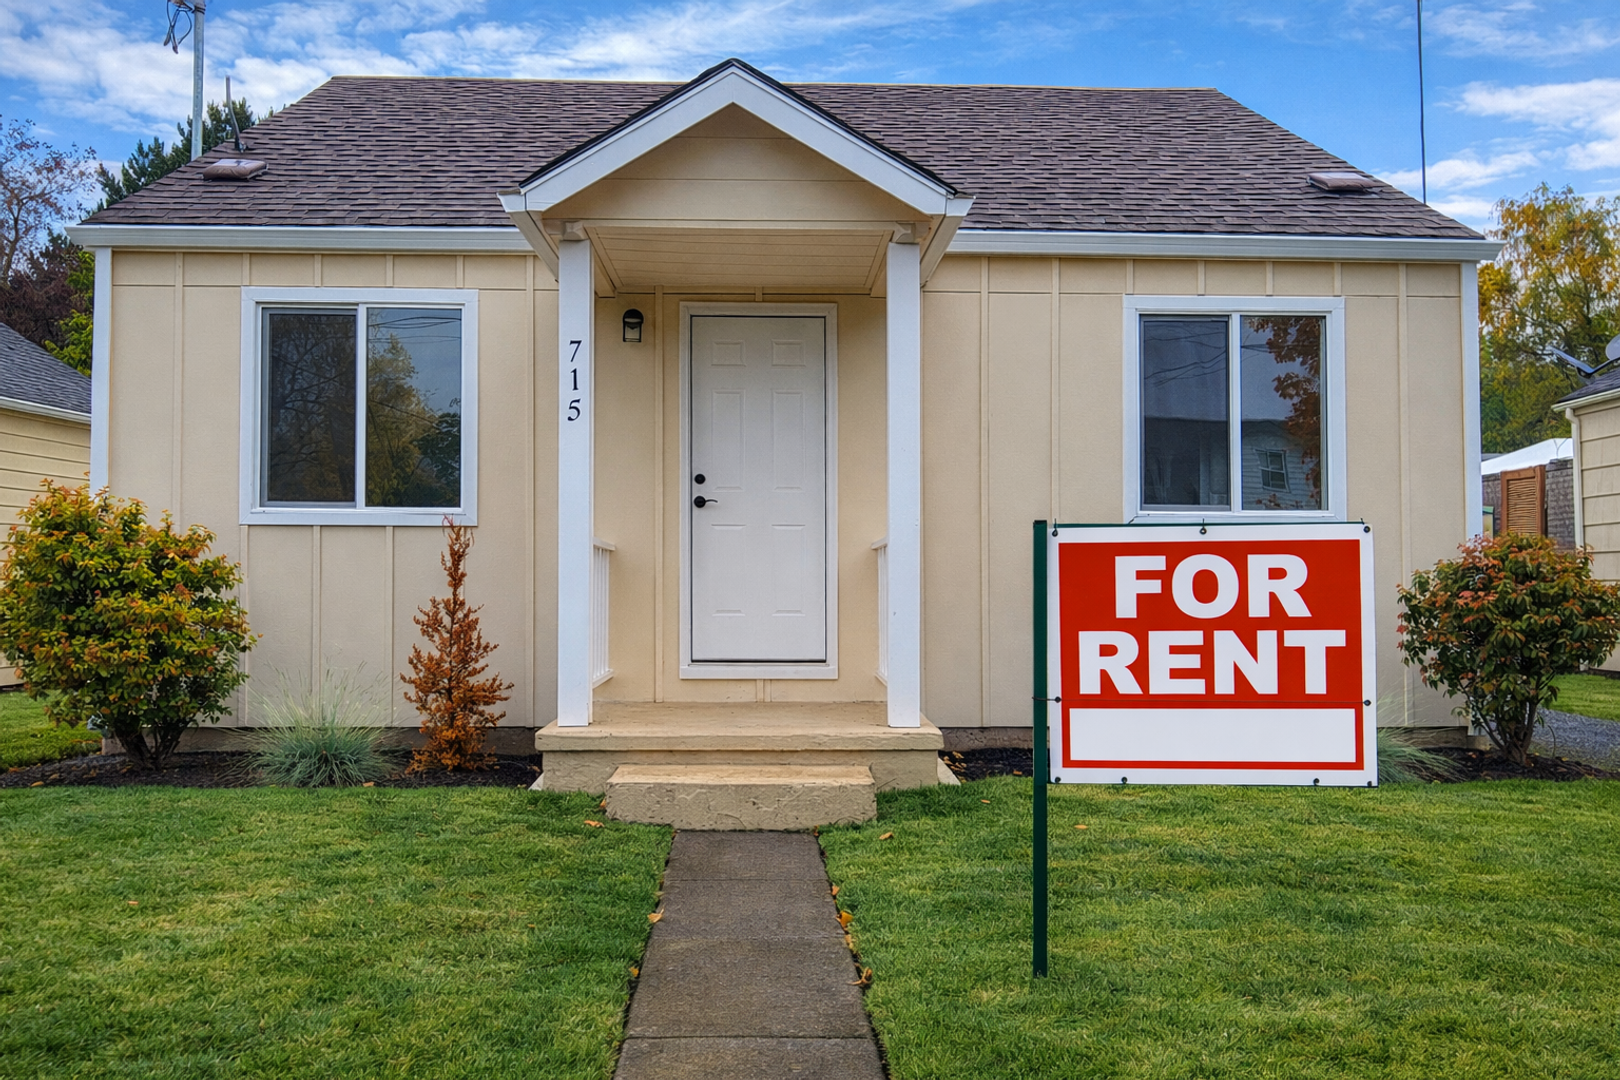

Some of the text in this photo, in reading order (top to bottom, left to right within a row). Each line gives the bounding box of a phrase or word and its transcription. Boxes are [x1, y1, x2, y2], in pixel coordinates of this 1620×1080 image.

[567, 339, 583, 422] 715
[1114, 553, 1312, 619] FOR
[1078, 629, 1346, 695] RENT
